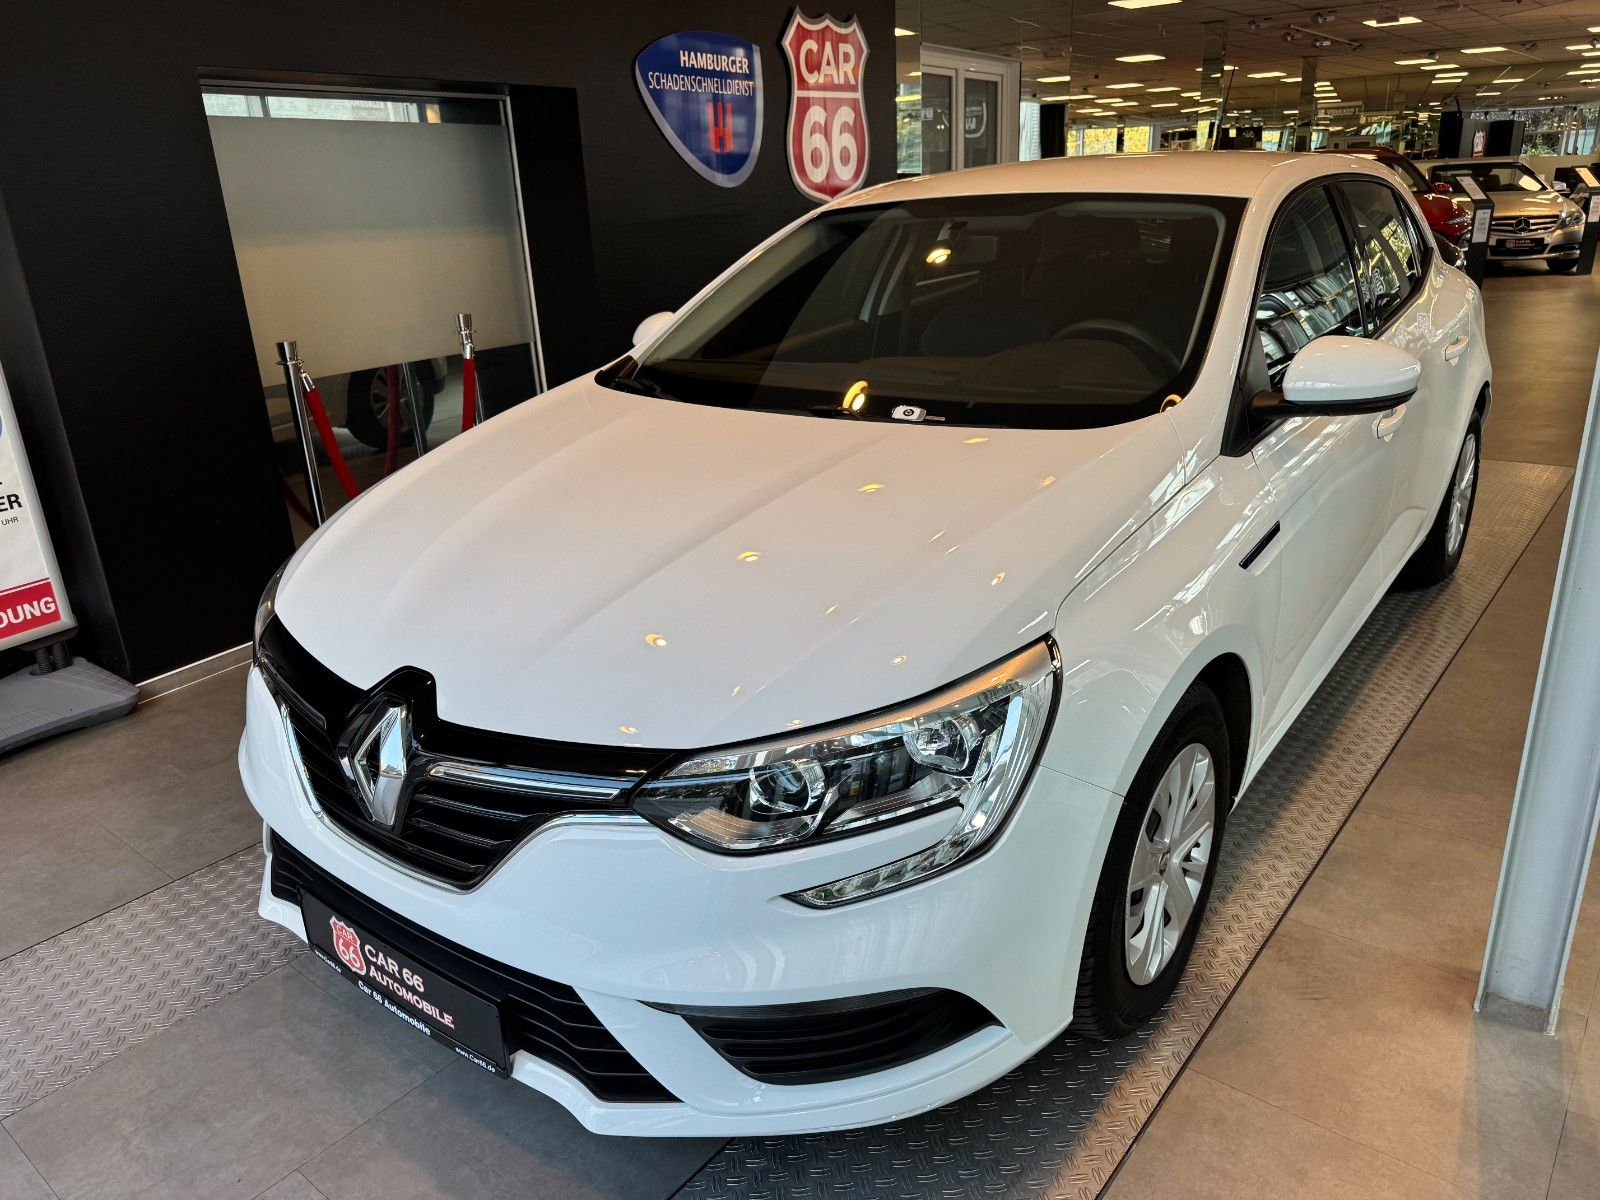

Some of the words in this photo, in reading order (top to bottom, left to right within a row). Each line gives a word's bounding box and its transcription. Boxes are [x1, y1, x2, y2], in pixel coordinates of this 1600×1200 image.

[679, 50, 749, 74] HAMBURGER
[799, 39, 856, 86] CAR
[648, 71, 754, 96] SCHADENSCHNELLDIENST
[802, 105, 858, 183] 66
[1, 516, 19, 526] UHR
[336, 924, 354, 942] CAR
[338, 938, 361, 968] 66
[364, 944, 401, 979] CAR
[402, 967, 425, 993] 66
[358, 980, 372, 996] Car
[384, 999, 431, 1036] Automobile
[369, 964, 455, 1030] AUTOMOBILE
